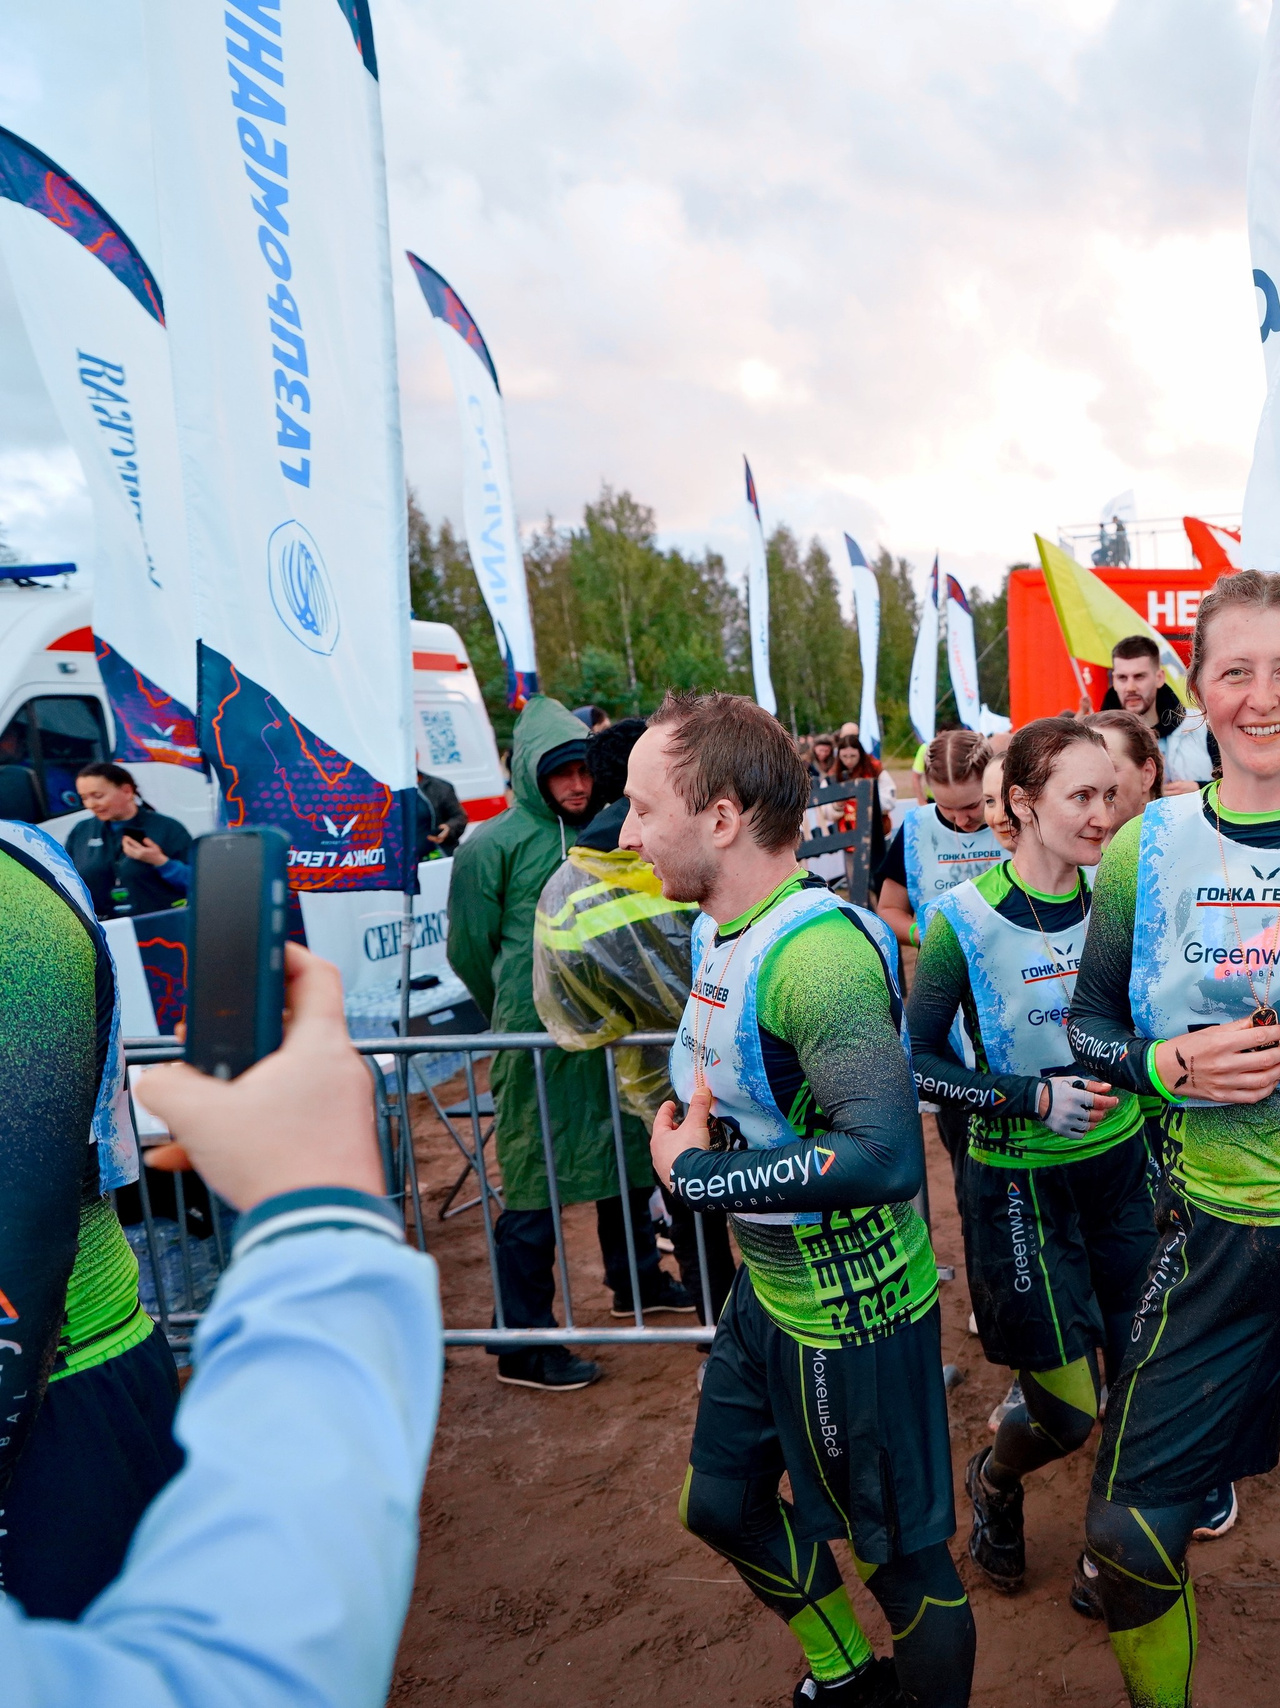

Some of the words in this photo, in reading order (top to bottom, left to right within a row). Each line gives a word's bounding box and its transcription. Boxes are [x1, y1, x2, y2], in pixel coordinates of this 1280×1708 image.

[1147, 590, 1206, 627] HE
[937, 853, 966, 861] ГОНКА
[968, 850, 1002, 859] ГЕРОЕВ
[1196, 887, 1256, 901] ГОНКА
[1021, 962, 1066, 980] ГОНКА
[912, 1071, 991, 1107] eenway
[706, 1193, 786, 1211] GLOBAL
[1007, 1196, 1032, 1293] Greenway
